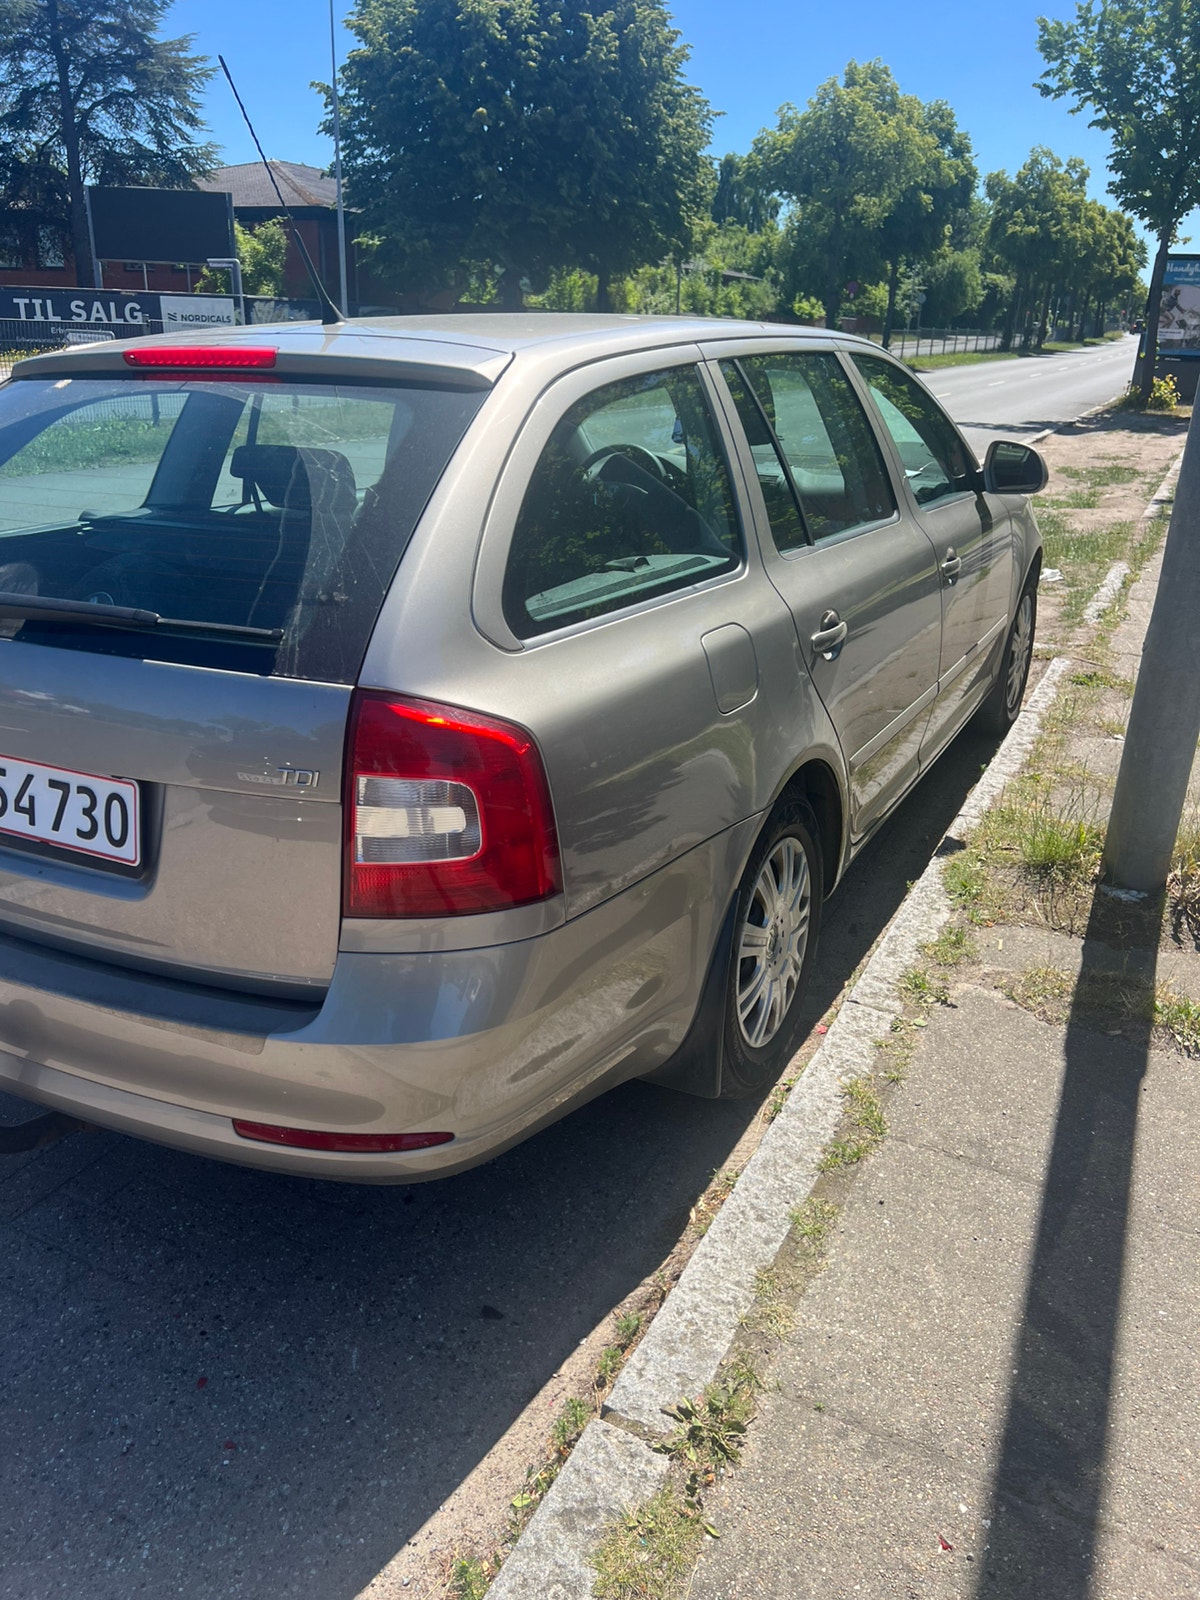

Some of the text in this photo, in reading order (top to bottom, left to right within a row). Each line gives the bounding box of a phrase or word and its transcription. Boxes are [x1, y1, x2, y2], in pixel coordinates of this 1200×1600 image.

[13, 298, 143, 323] TIL SALG
[180, 313, 232, 323] NORDICALS
[276, 767, 320, 788] TDI
